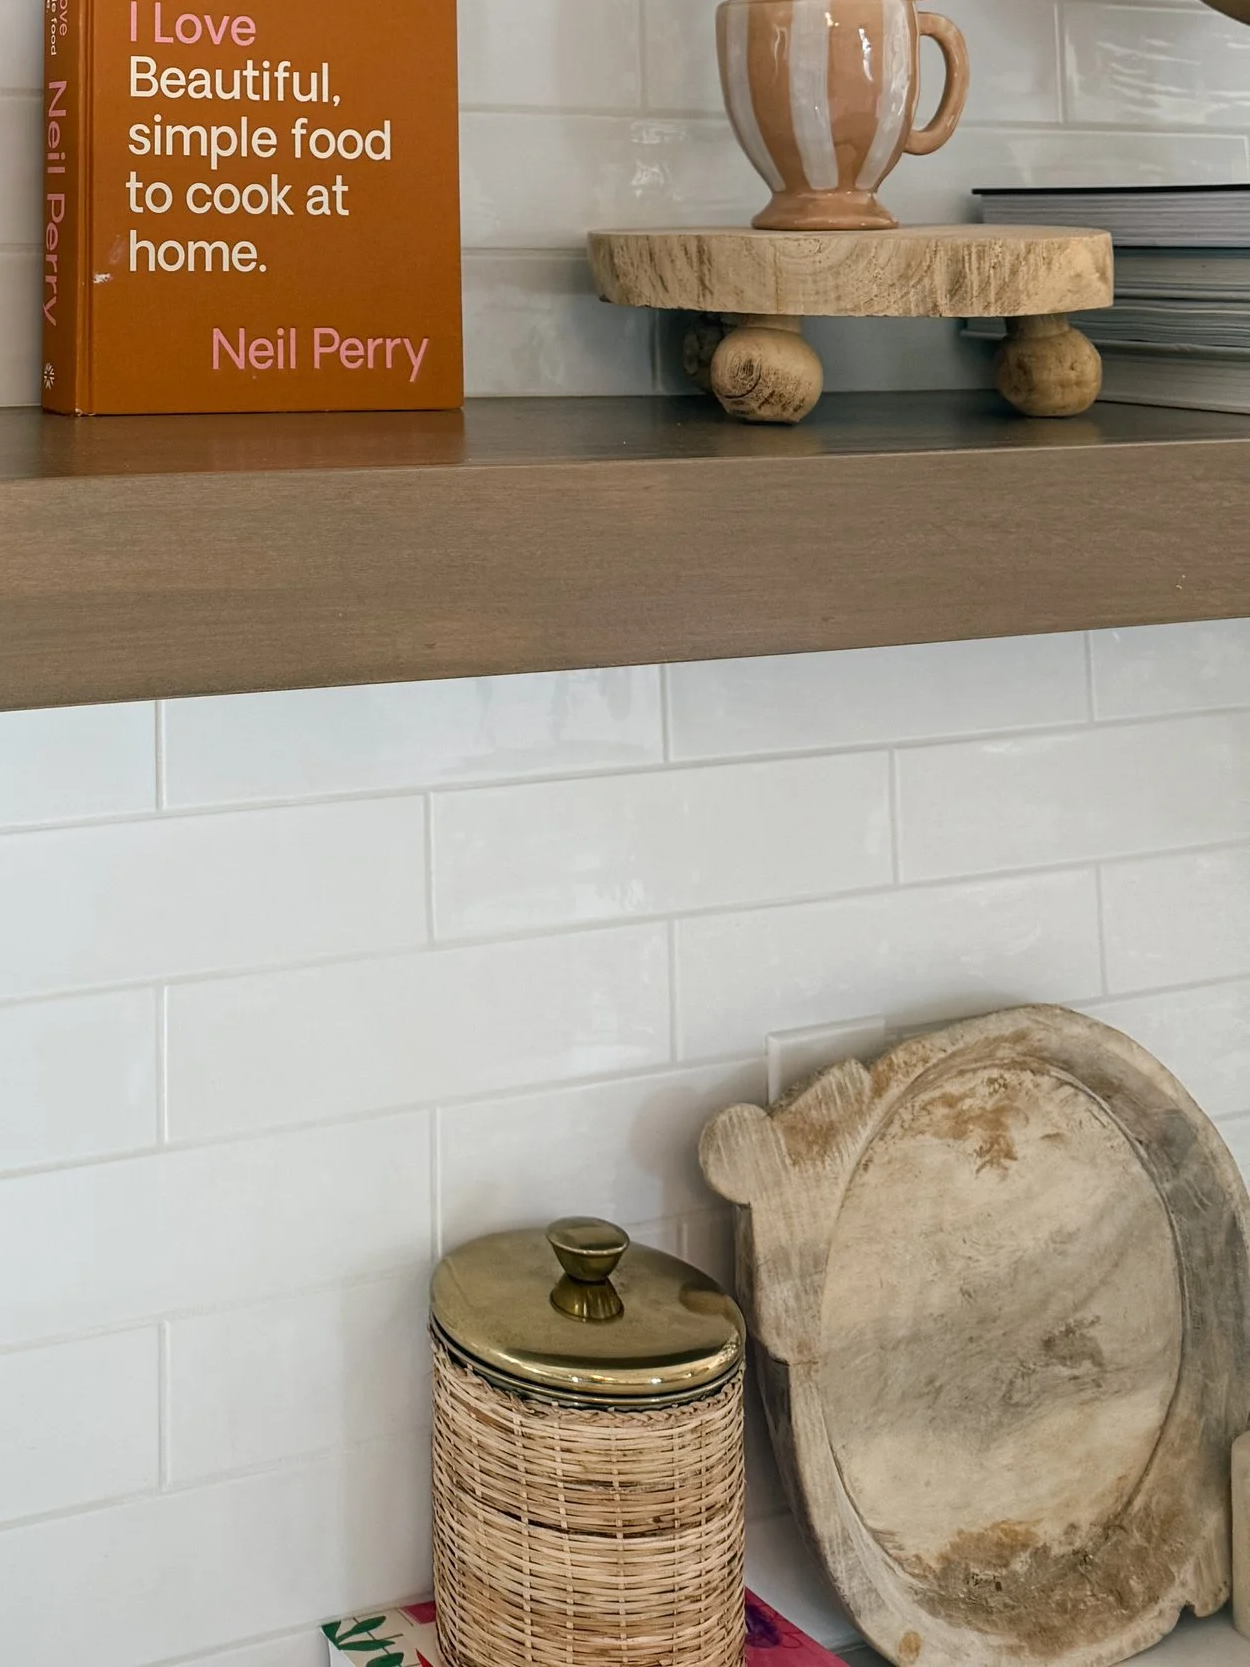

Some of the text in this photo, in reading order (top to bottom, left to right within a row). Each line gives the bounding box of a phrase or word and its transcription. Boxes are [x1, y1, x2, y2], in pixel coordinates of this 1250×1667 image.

[50, 17, 58, 56] food
[130, 1, 256, 46] I Love
[130, 55, 341, 107] Beautiful,
[128, 114, 391, 170] simple food
[42, 80, 67, 327] Neil Perry
[125, 171, 350, 216] to cook at
[129, 229, 267, 273] home.
[212, 327, 429, 382] Neil Perry
